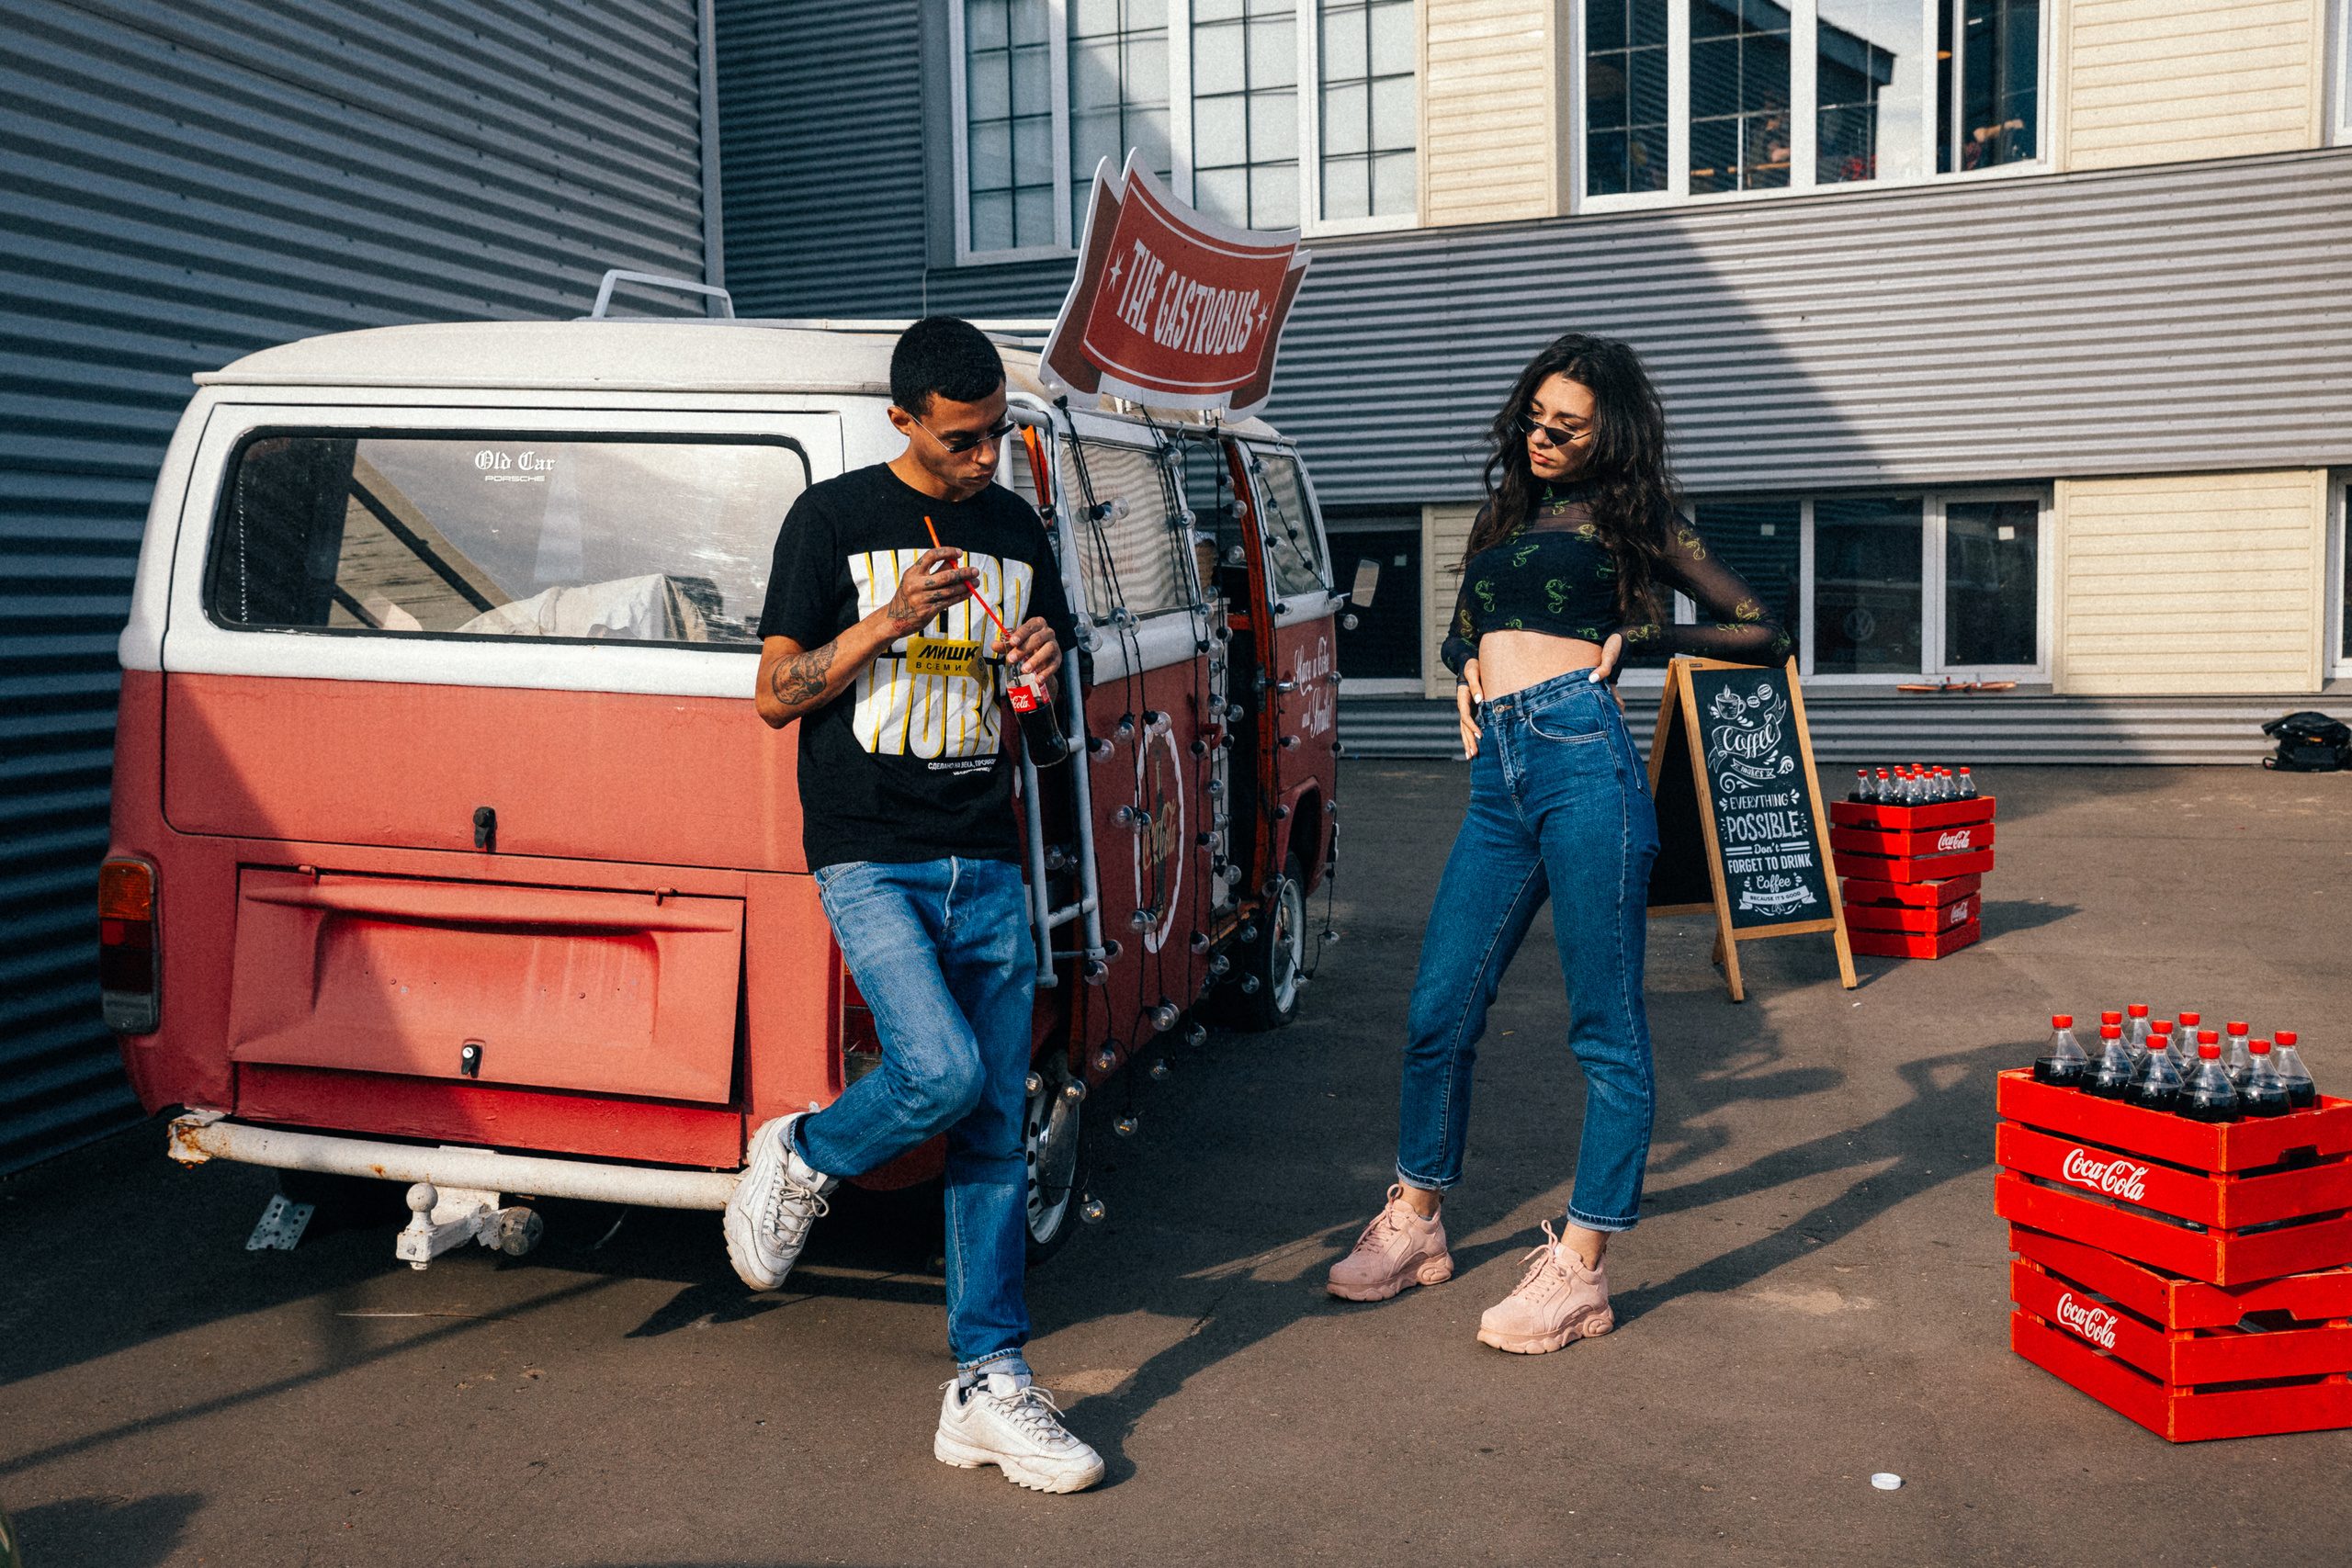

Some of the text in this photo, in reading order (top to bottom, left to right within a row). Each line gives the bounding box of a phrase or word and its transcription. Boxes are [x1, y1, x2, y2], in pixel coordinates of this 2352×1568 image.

[1116, 238, 1260, 355] THE GASTROBUS
[475, 449, 556, 471] Old Car
[847, 548, 1034, 659] WIRD
[1723, 724, 1776, 760] Coffee
[1740, 766, 1764, 778] makes
[1729, 793, 1789, 810] EVERYTHING
[1725, 810, 1803, 842] POSSIBLE
[1754, 842, 1781, 854] Don't
[1727, 853, 1813, 874] FORGET TO DRINK
[1756, 874, 1792, 893] Coffee
[1785, 891, 1801, 899] GOOD
[2063, 1148, 2149, 1201] Coca-Cola
[2057, 1292, 2119, 1349] Coca-Cola
